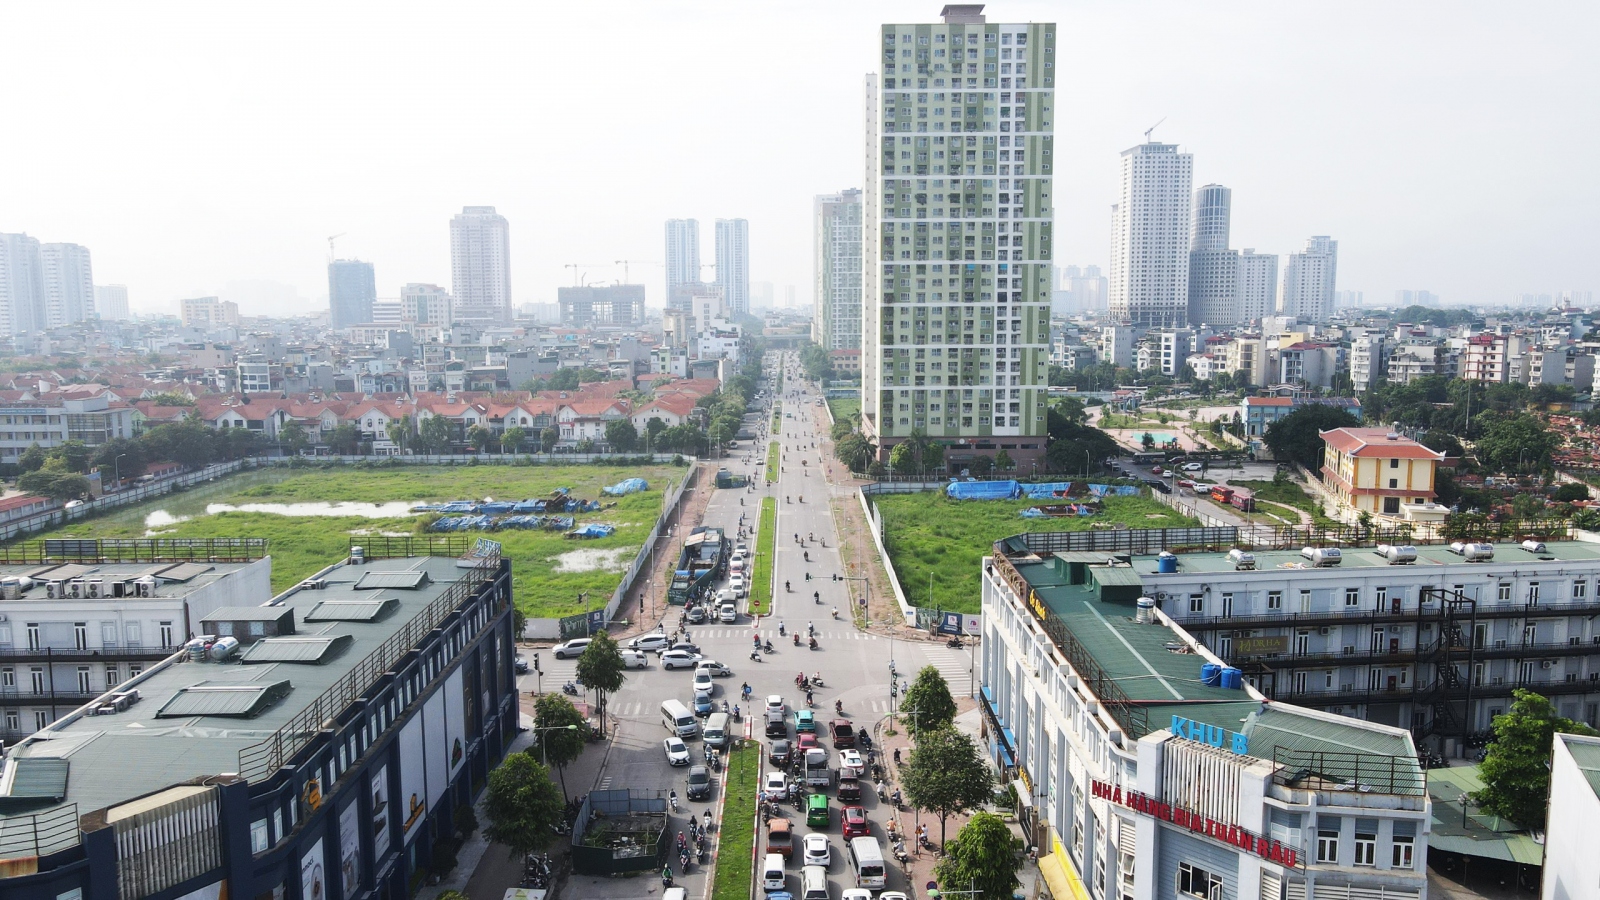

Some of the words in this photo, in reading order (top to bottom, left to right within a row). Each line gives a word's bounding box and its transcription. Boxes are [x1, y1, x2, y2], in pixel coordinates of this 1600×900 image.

[1171, 714, 1224, 748] KHU
[1232, 731, 1248, 755] B
[1091, 779, 1122, 805] NHÀ
[1126, 791, 1171, 822] HÀNG
[1173, 807, 1203, 833] BIA
[1256, 837, 1296, 868] RÂU
